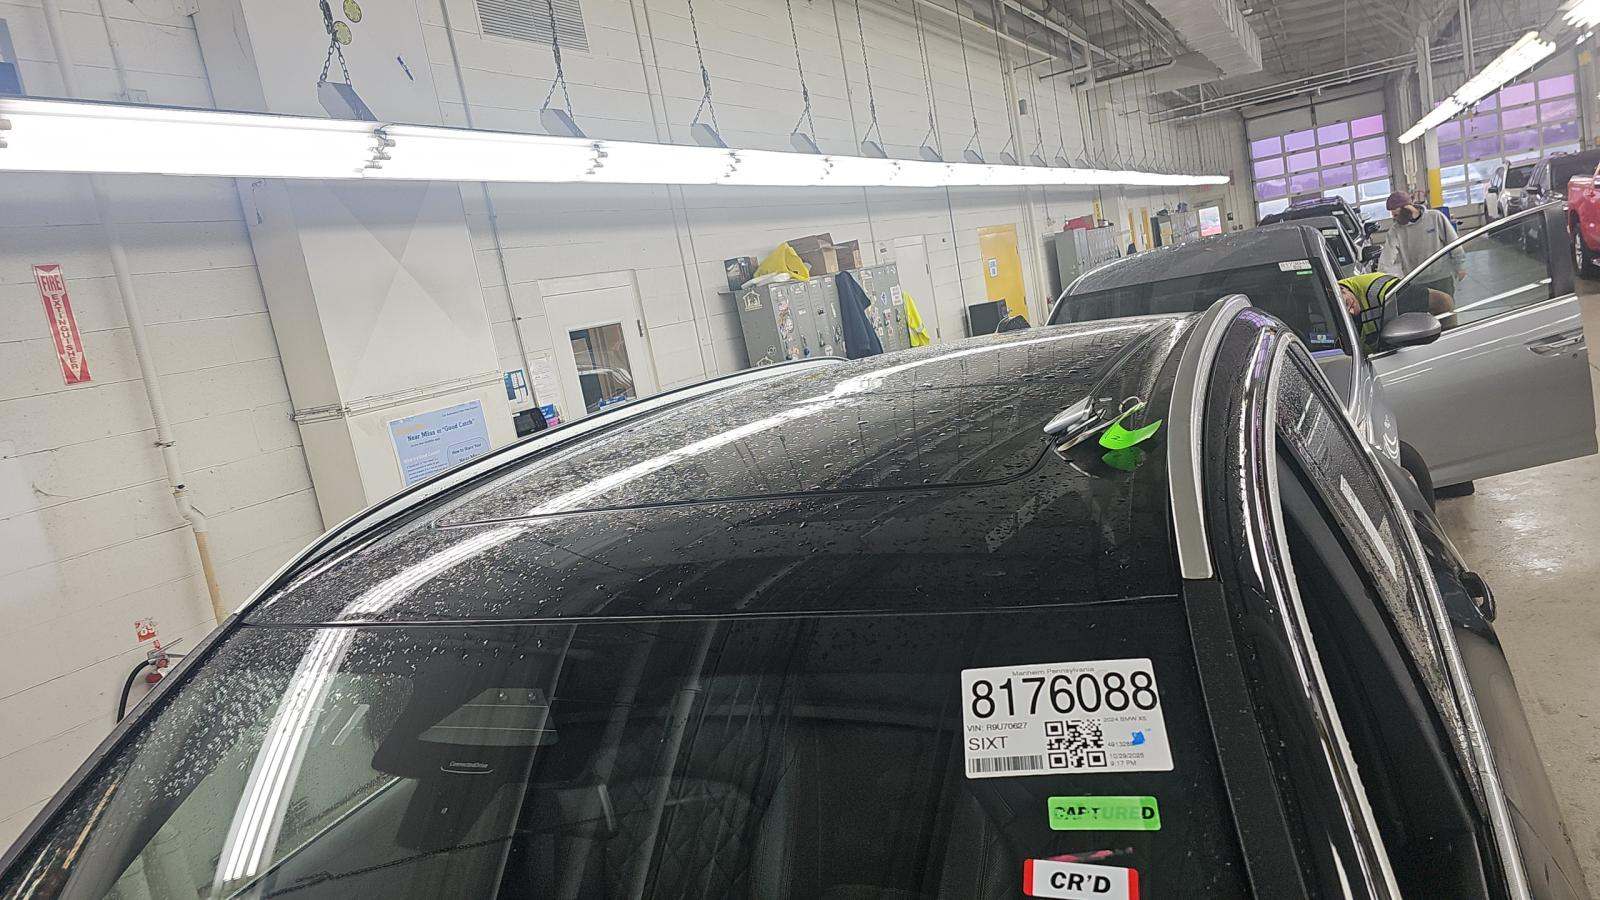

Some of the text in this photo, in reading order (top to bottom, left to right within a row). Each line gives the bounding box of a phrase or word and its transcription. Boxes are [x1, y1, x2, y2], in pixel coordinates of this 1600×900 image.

[41, 275, 62, 291] FIRE
[51, 293, 79, 370] EXTINGUISHER
[407, 433, 420, 442] Near
[421, 429, 435, 438] Miss
[442, 424, 458, 432] "Good
[458, 418, 475, 428] Catch"
[1046, 667, 1095, 676] Pennsylvania
[971, 670, 1158, 719] 8176088
[966, 721, 1028, 732] VIN: R9U70627
[968, 735, 1008, 751] SIXT
[1054, 806, 1155, 820] CAPTURED
[1050, 871, 1111, 894] CR'D
